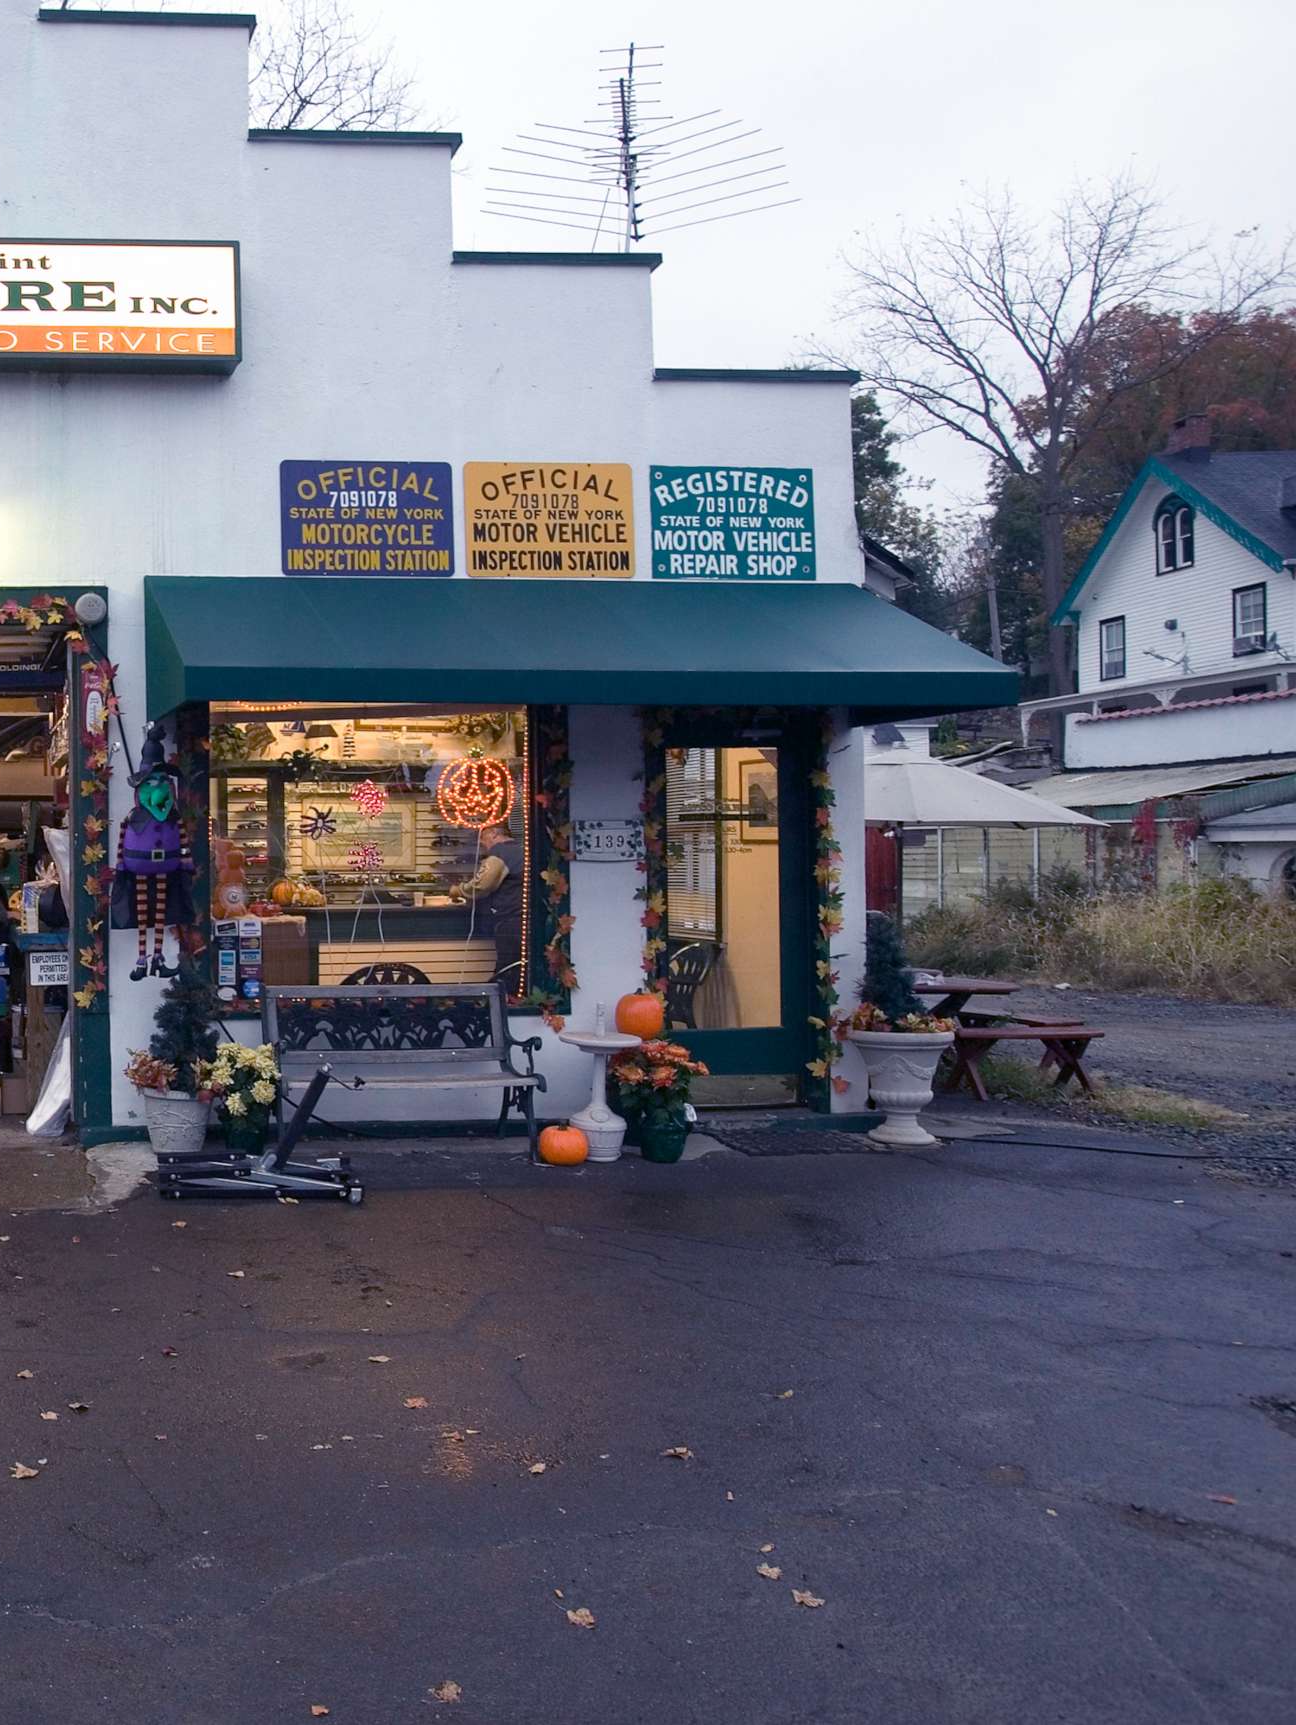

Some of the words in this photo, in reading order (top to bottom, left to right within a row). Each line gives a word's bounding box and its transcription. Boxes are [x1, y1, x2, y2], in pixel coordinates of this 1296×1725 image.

[129, 297, 218, 316] INC.
[45, 331, 217, 353] SERVICE
[297, 466, 440, 502] OFFICIAL
[481, 468, 620, 502] OFFICIAL
[654, 470, 809, 509] REGISTERED
[329, 491, 398, 508] 7091078
[511, 493, 579, 509] 7091078
[696, 497, 768, 514] 7091078
[289, 507, 335, 519] STATE
[341, 508, 360, 519] OF
[366, 508, 398, 519] NEW
[404, 508, 444, 520] YORK
[474, 509, 517, 520] STATE
[523, 509, 542, 520] OF
[547, 509, 579, 520] NEW
[585, 510, 624, 521] YORK
[660, 515, 701, 527] STATE
[706, 516, 724, 527] OF
[729, 516, 762, 528] NEW
[768, 517, 805, 528] YORK
[302, 523, 434, 545] MOTORCYCLE
[473, 522, 538, 543] MOTOR
[545, 523, 627, 543] VEHICLE
[654, 530, 725, 551] MOTOR
[733, 530, 813, 552] VEHICLE
[287, 549, 381, 570] INSPECTION
[385, 549, 449, 571] STATION
[472, 549, 562, 571] INSPECTION
[568, 550, 630, 571] STATION
[670, 553, 738, 575] REPAIR
[747, 554, 797, 576] SHOP
[594, 835, 625, 848] 139
[32, 955, 61, 964] EMPLOYEES
[45, 974, 55, 982] THIS
